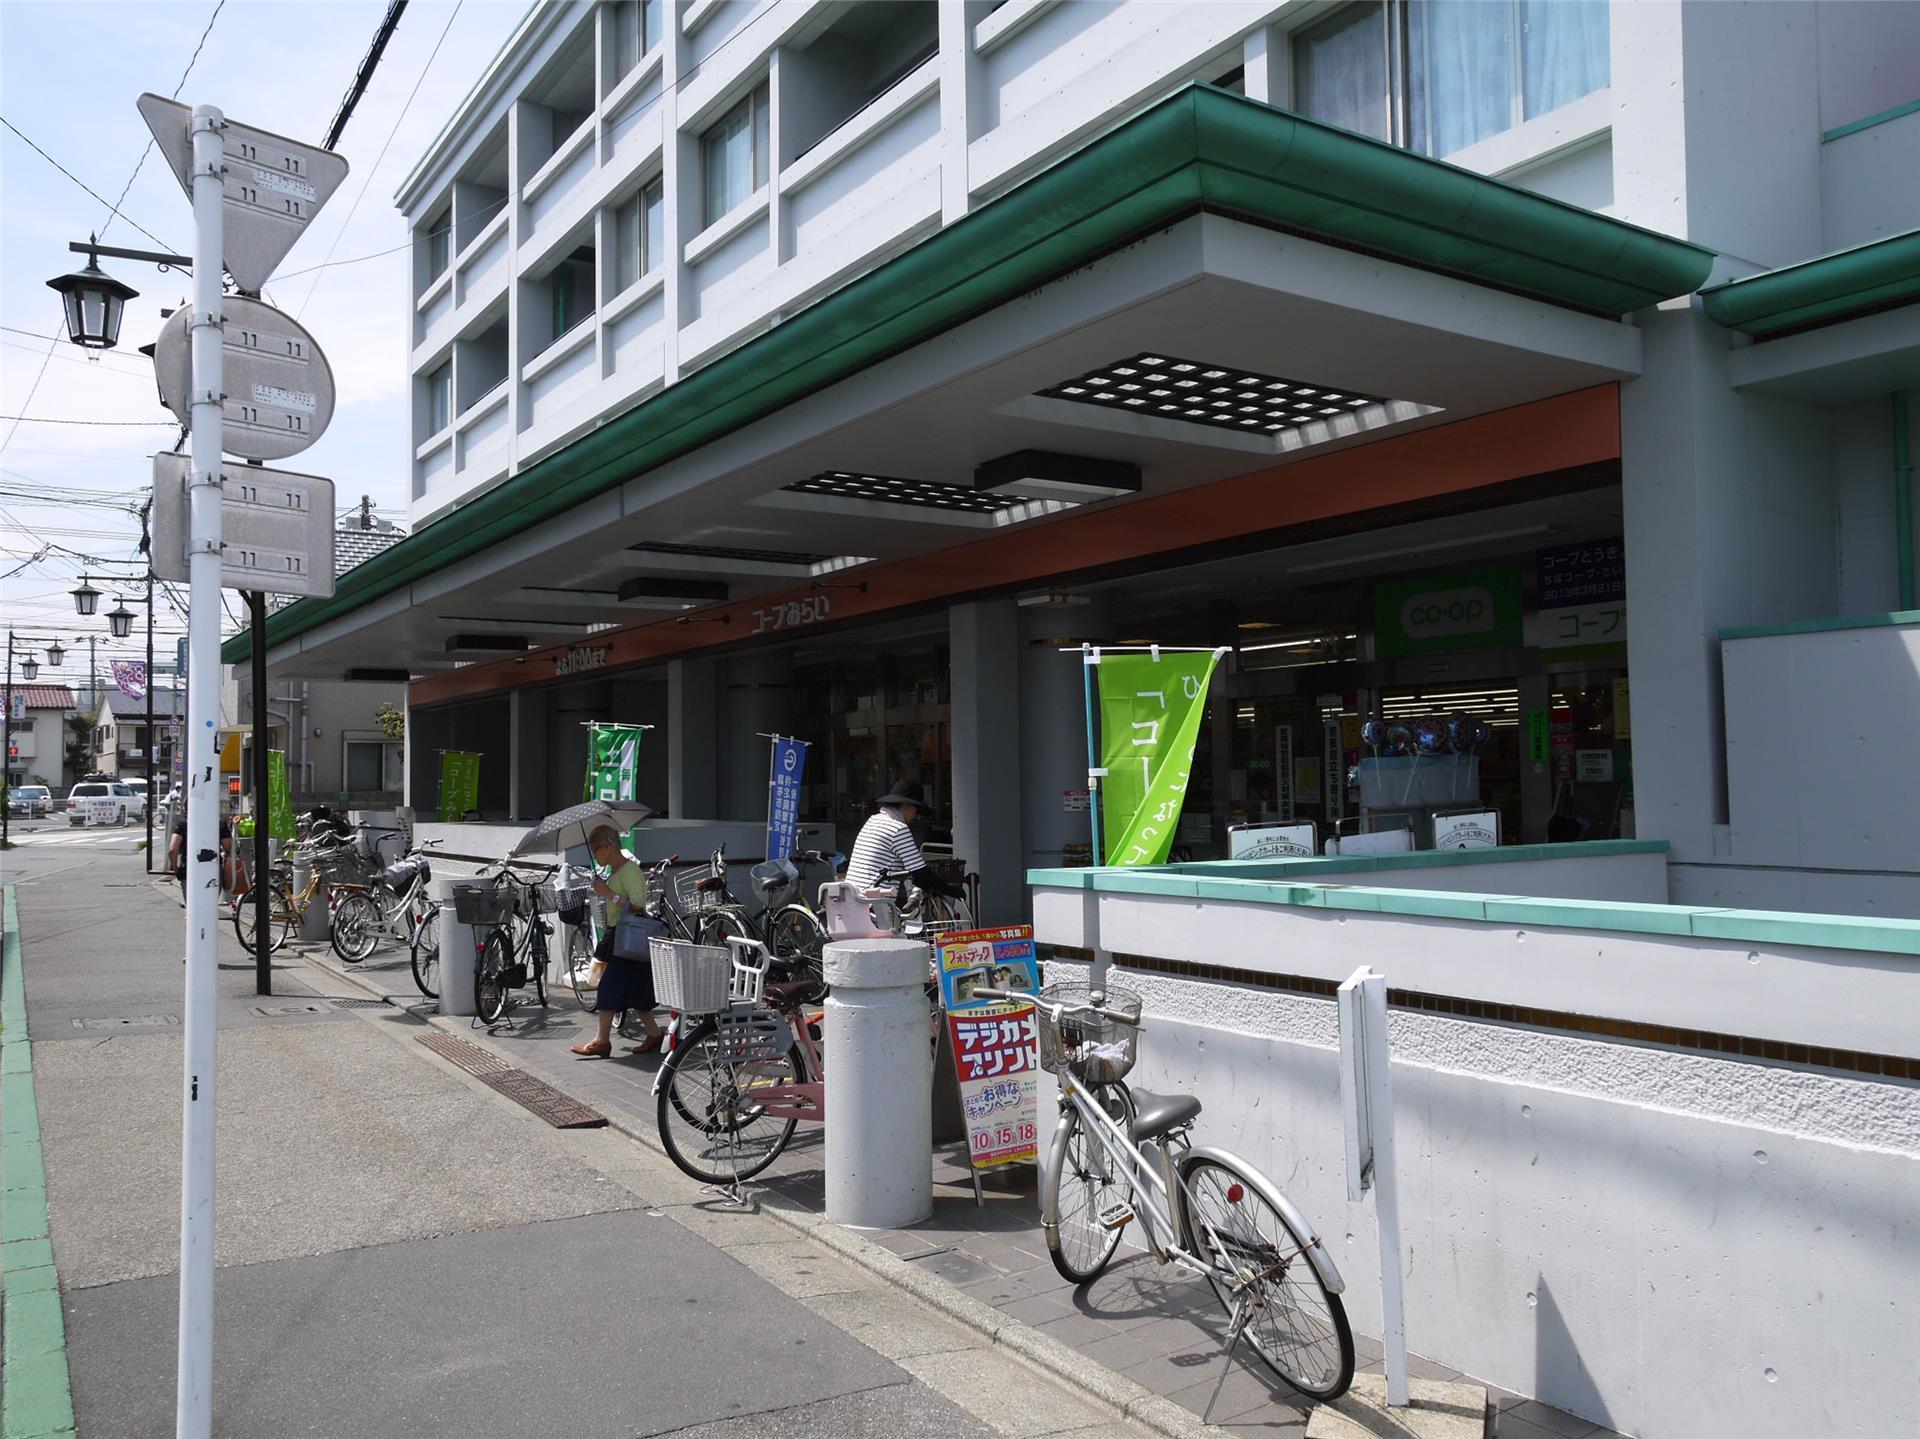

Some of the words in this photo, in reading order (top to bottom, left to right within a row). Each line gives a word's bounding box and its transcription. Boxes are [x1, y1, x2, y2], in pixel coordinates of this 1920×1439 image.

[751, 594, 831, 634] コープみらい
[956, 1012, 1037, 1050] デジカメ
[961, 1044, 1037, 1078] プリント
[968, 1095, 1022, 1118] キャンペーン
[972, 1132, 989, 1151] 10
[996, 1127, 1012, 1146] 15
[1018, 1123, 1034, 1141] 18
